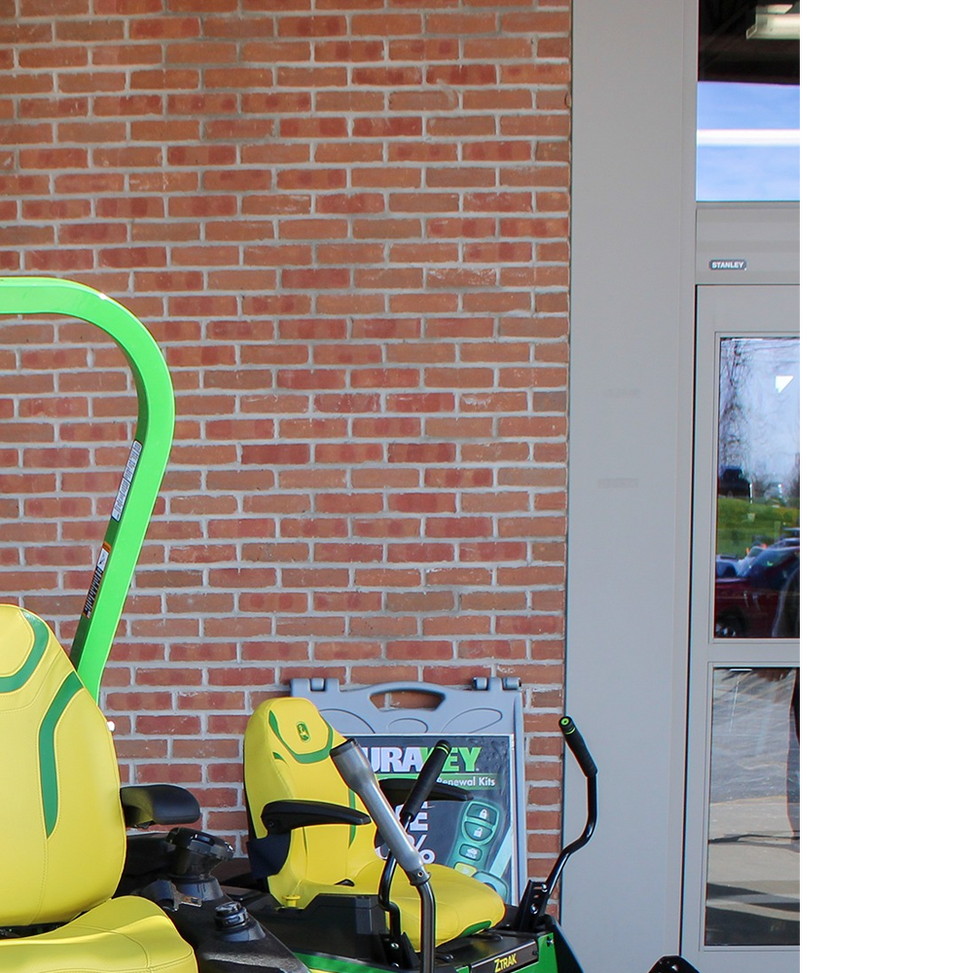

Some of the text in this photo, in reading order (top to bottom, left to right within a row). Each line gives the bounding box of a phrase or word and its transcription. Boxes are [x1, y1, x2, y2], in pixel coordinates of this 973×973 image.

[711, 261, 744, 269] STANLEY
[478, 776, 496, 787] Kits
[494, 953, 518, 973] ZTRAK
